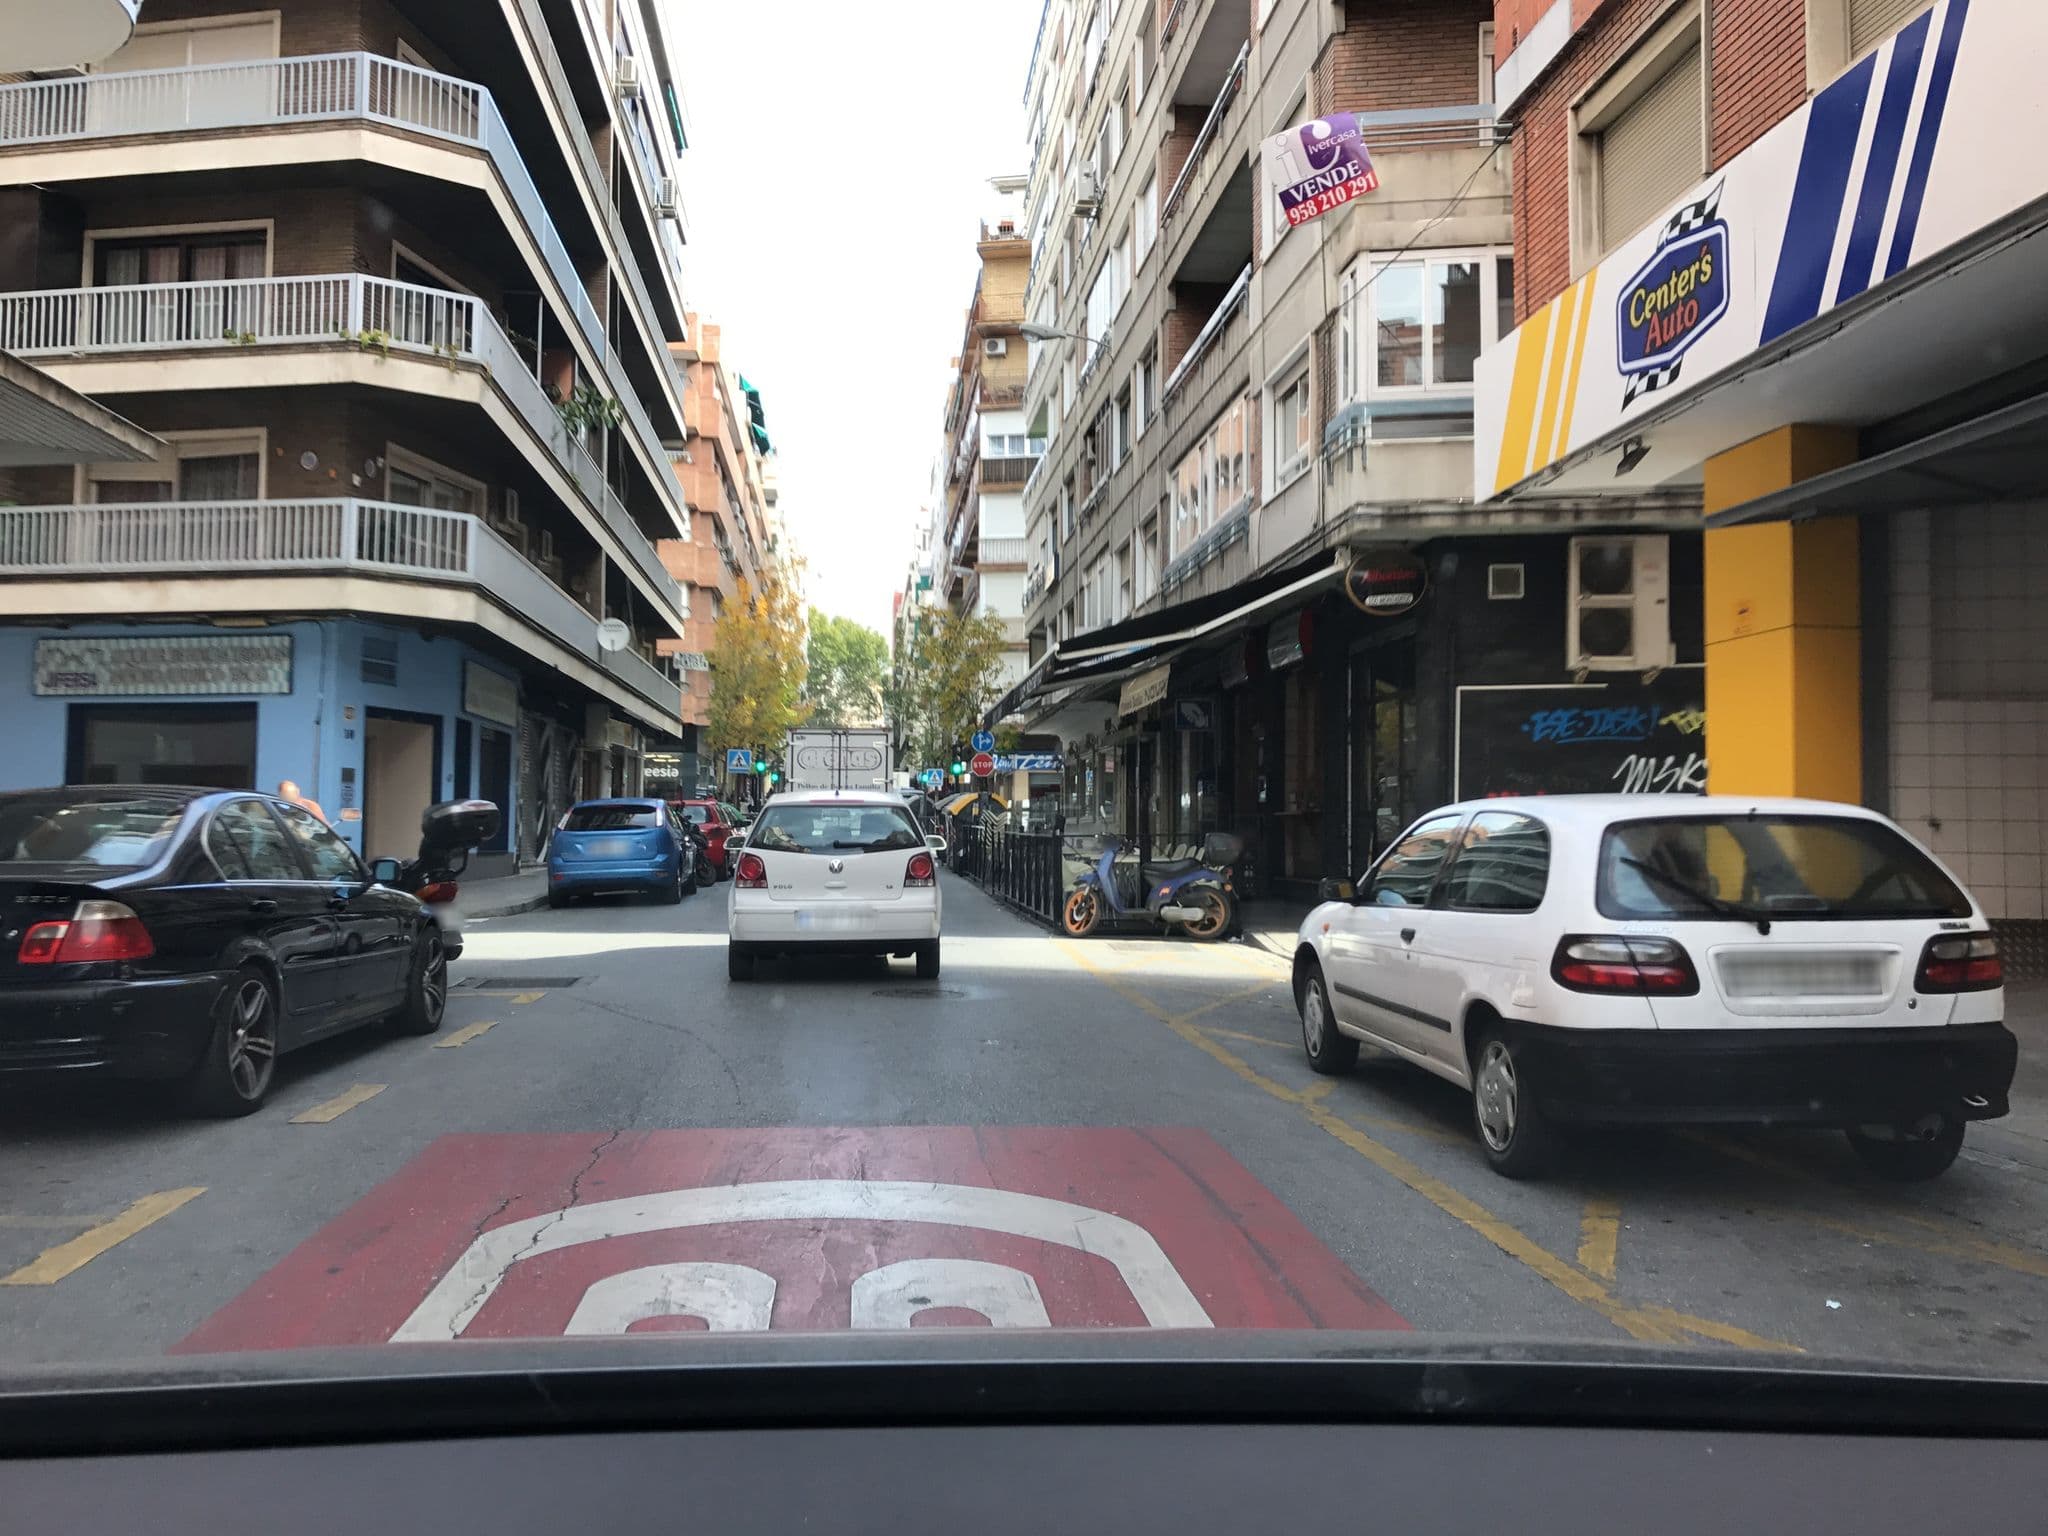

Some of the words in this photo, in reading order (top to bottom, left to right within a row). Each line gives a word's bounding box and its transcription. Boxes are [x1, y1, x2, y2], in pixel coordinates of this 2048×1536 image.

[1307, 129, 1357, 155] Ivercasa
[1289, 159, 1362, 203] VENDE
[1290, 199, 1318, 225] 958
[1318, 185, 1348, 212] 210
[1347, 172, 1377, 197] 291
[1630, 244, 1713, 328] Center's
[1645, 299, 1699, 354] Auto
[644, 765, 680, 778] eesia
